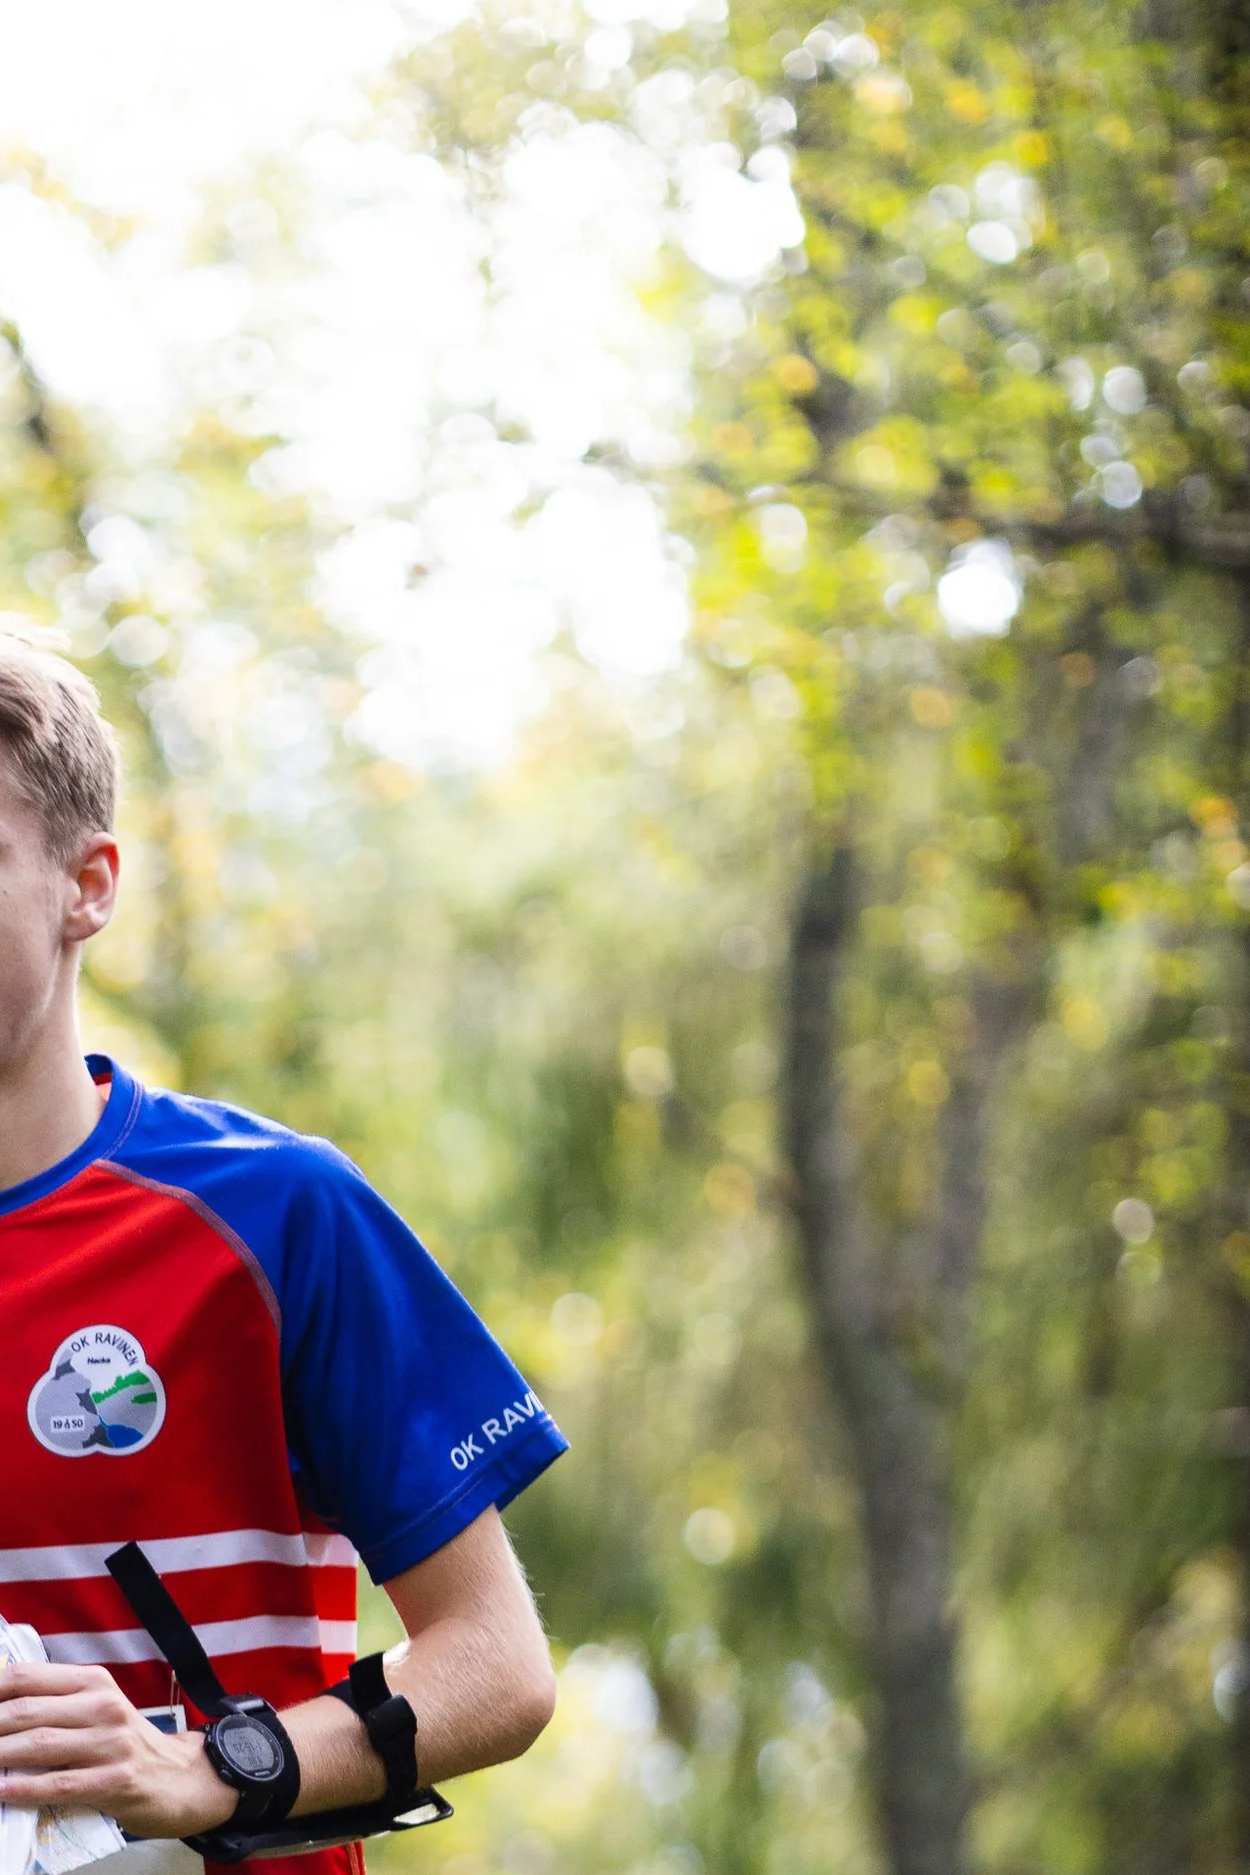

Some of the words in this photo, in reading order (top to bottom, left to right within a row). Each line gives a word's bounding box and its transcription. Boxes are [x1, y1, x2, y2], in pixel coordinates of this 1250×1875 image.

[71, 1336, 90, 1352] OK
[95, 1332, 139, 1367] RAVINEN
[450, 1433, 484, 1471] OK
